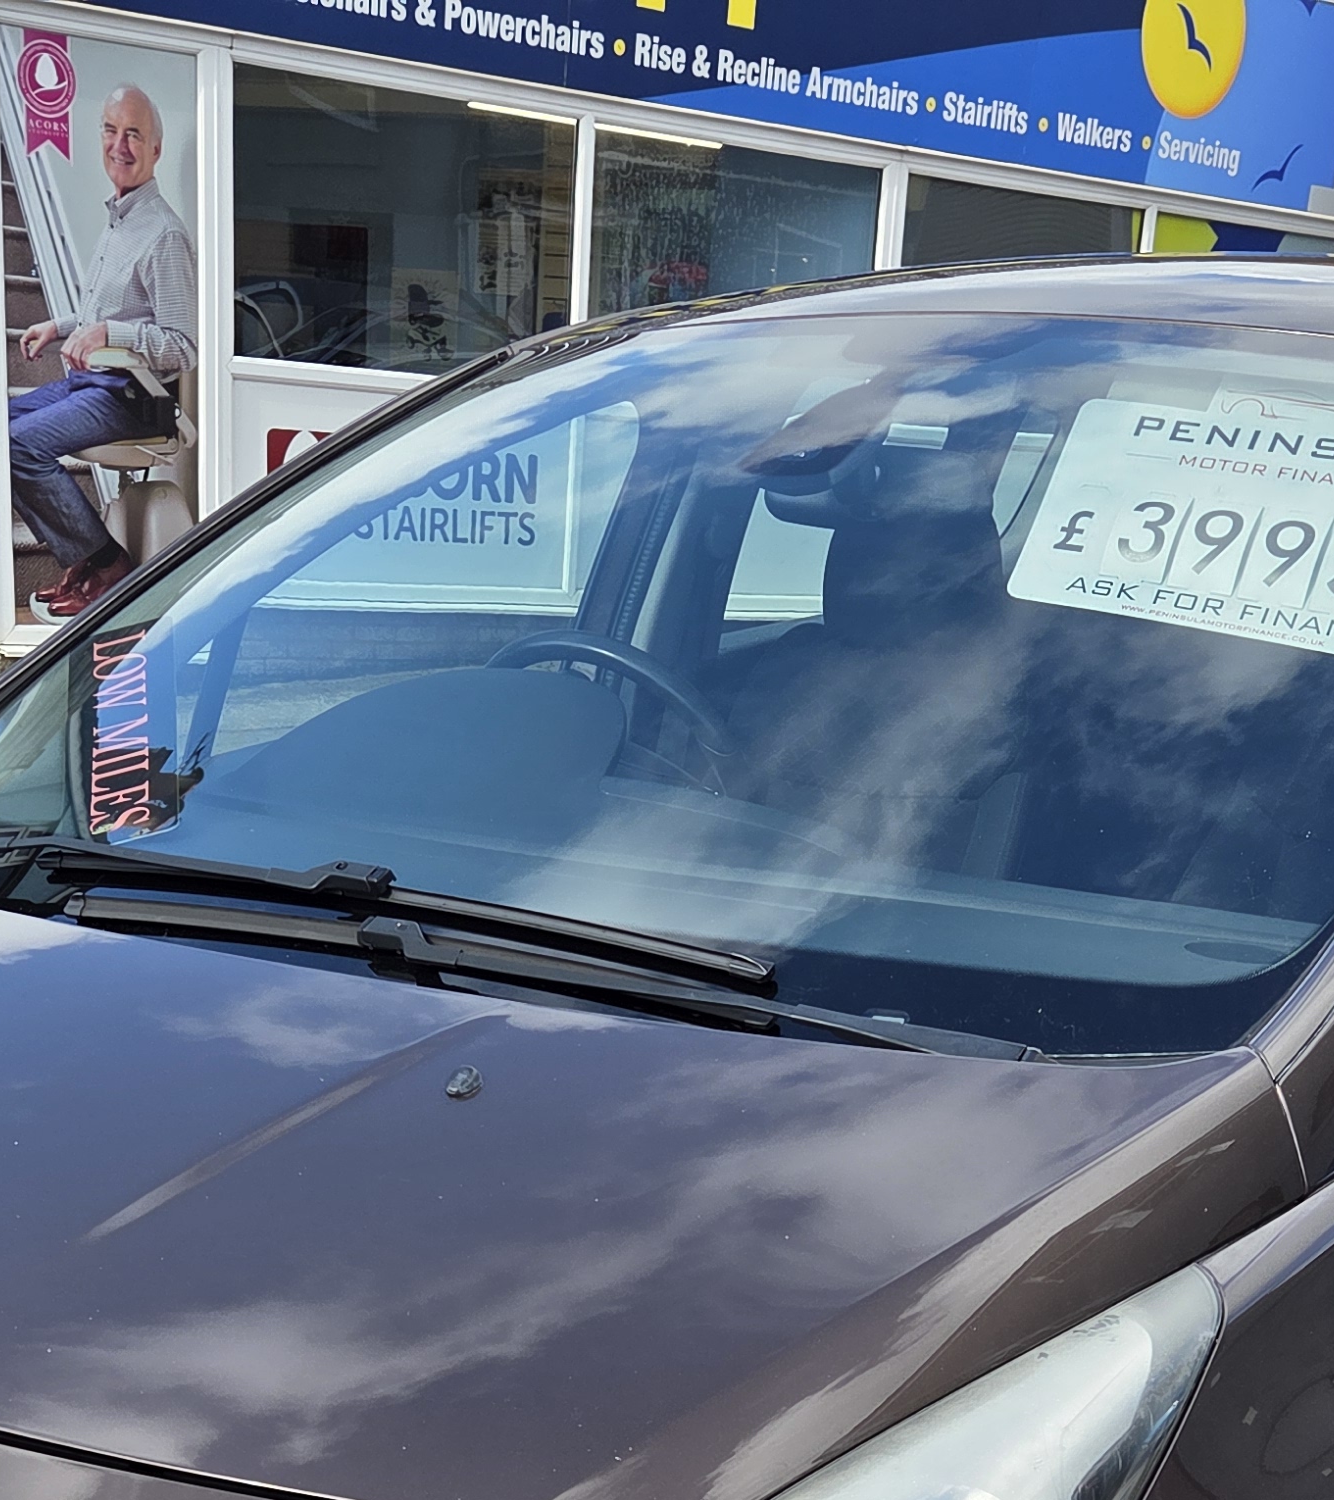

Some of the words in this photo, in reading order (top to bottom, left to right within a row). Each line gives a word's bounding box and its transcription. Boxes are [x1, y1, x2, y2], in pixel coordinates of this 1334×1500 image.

[414, 0, 436, 27] &
[444, 0, 605, 59] Powerchairs
[634, 33, 686, 74] Rise
[692, 45, 711, 79] &
[717, 49, 801, 94] Recline
[805, 67, 919, 116] Armchairs
[943, 91, 1028, 135] Stairlifts
[1057, 112, 1132, 153] Walkers
[1157, 130, 1241, 178] Servicing
[405, 453, 538, 504] ORN
[1179, 455, 1267, 477] MOTOR
[1053, 510, 1095, 553] £
[1066, 577, 1139, 601] ASK
[1153, 589, 1224, 616] FOR
[1121, 603, 1325, 647] WWW.PENINSULAMOTORFINANCE.CO.UK
[93, 629, 147, 710] LOW
[90, 714, 150, 835] MILES
